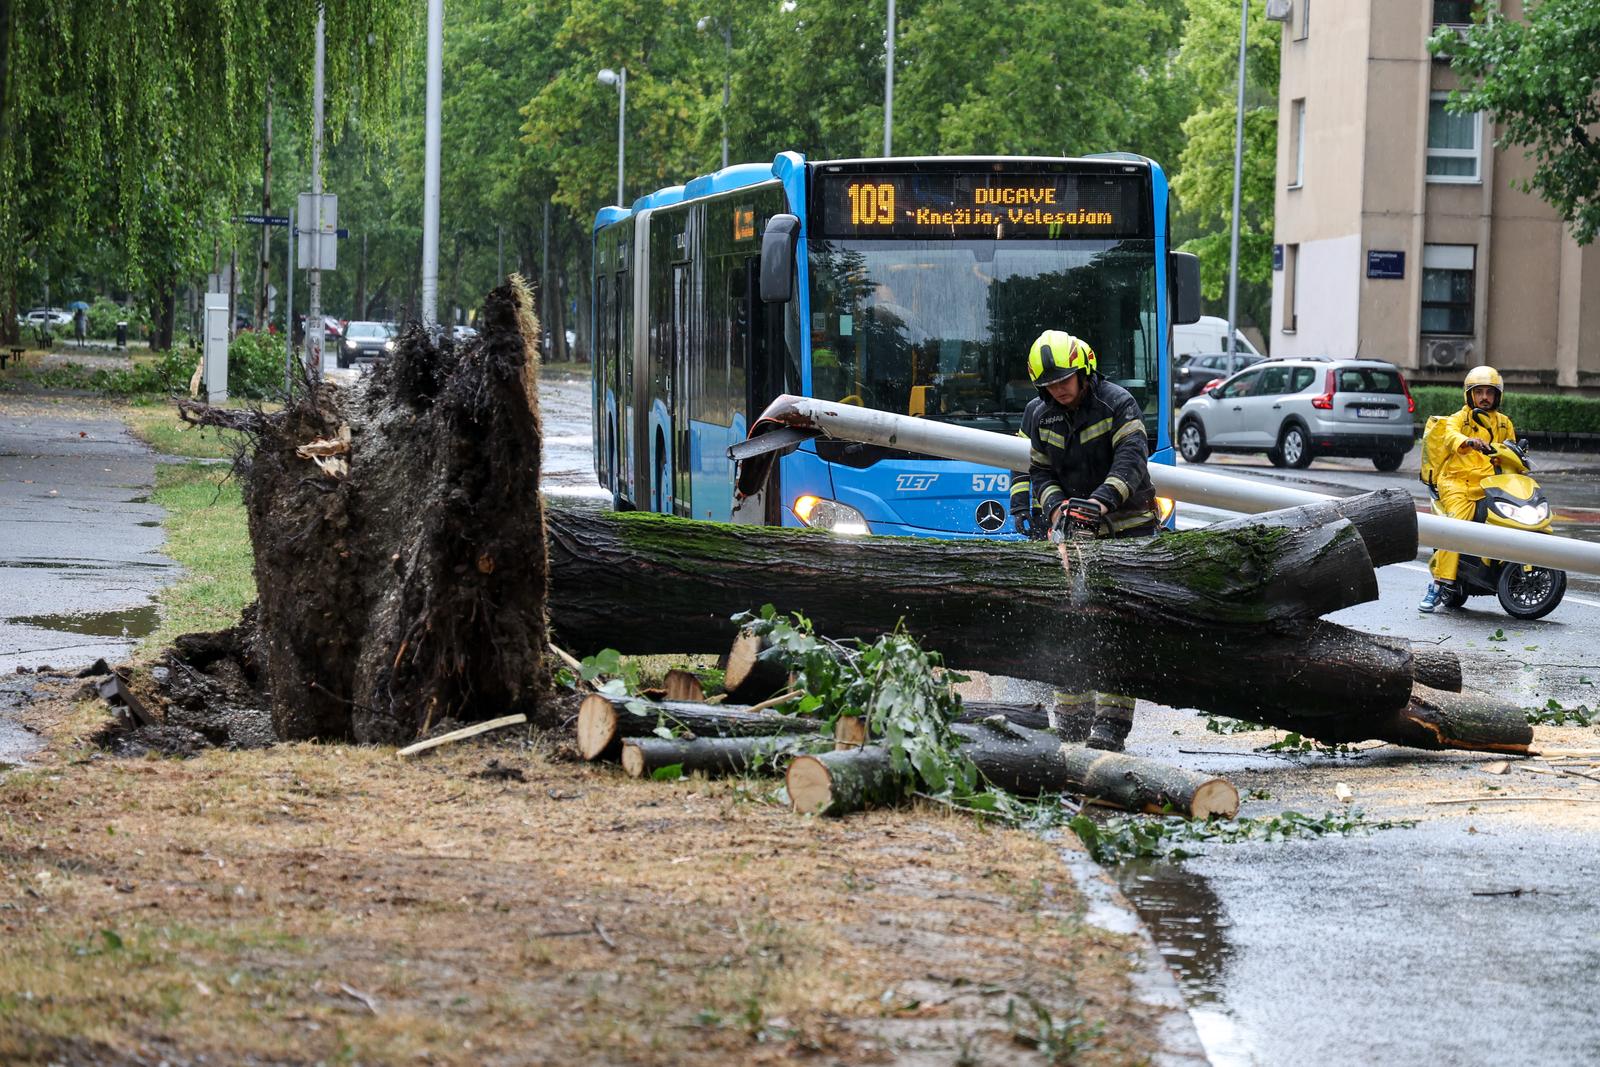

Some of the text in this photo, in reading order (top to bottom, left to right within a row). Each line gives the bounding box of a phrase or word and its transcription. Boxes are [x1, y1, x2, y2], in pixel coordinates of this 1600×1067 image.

[847, 183, 895, 225] 109
[975, 187, 1056, 204] DUGAVE
[1008, 209, 1113, 225] Velesajam
[896, 473, 940, 491] ZET
[971, 473, 1011, 492] 579
